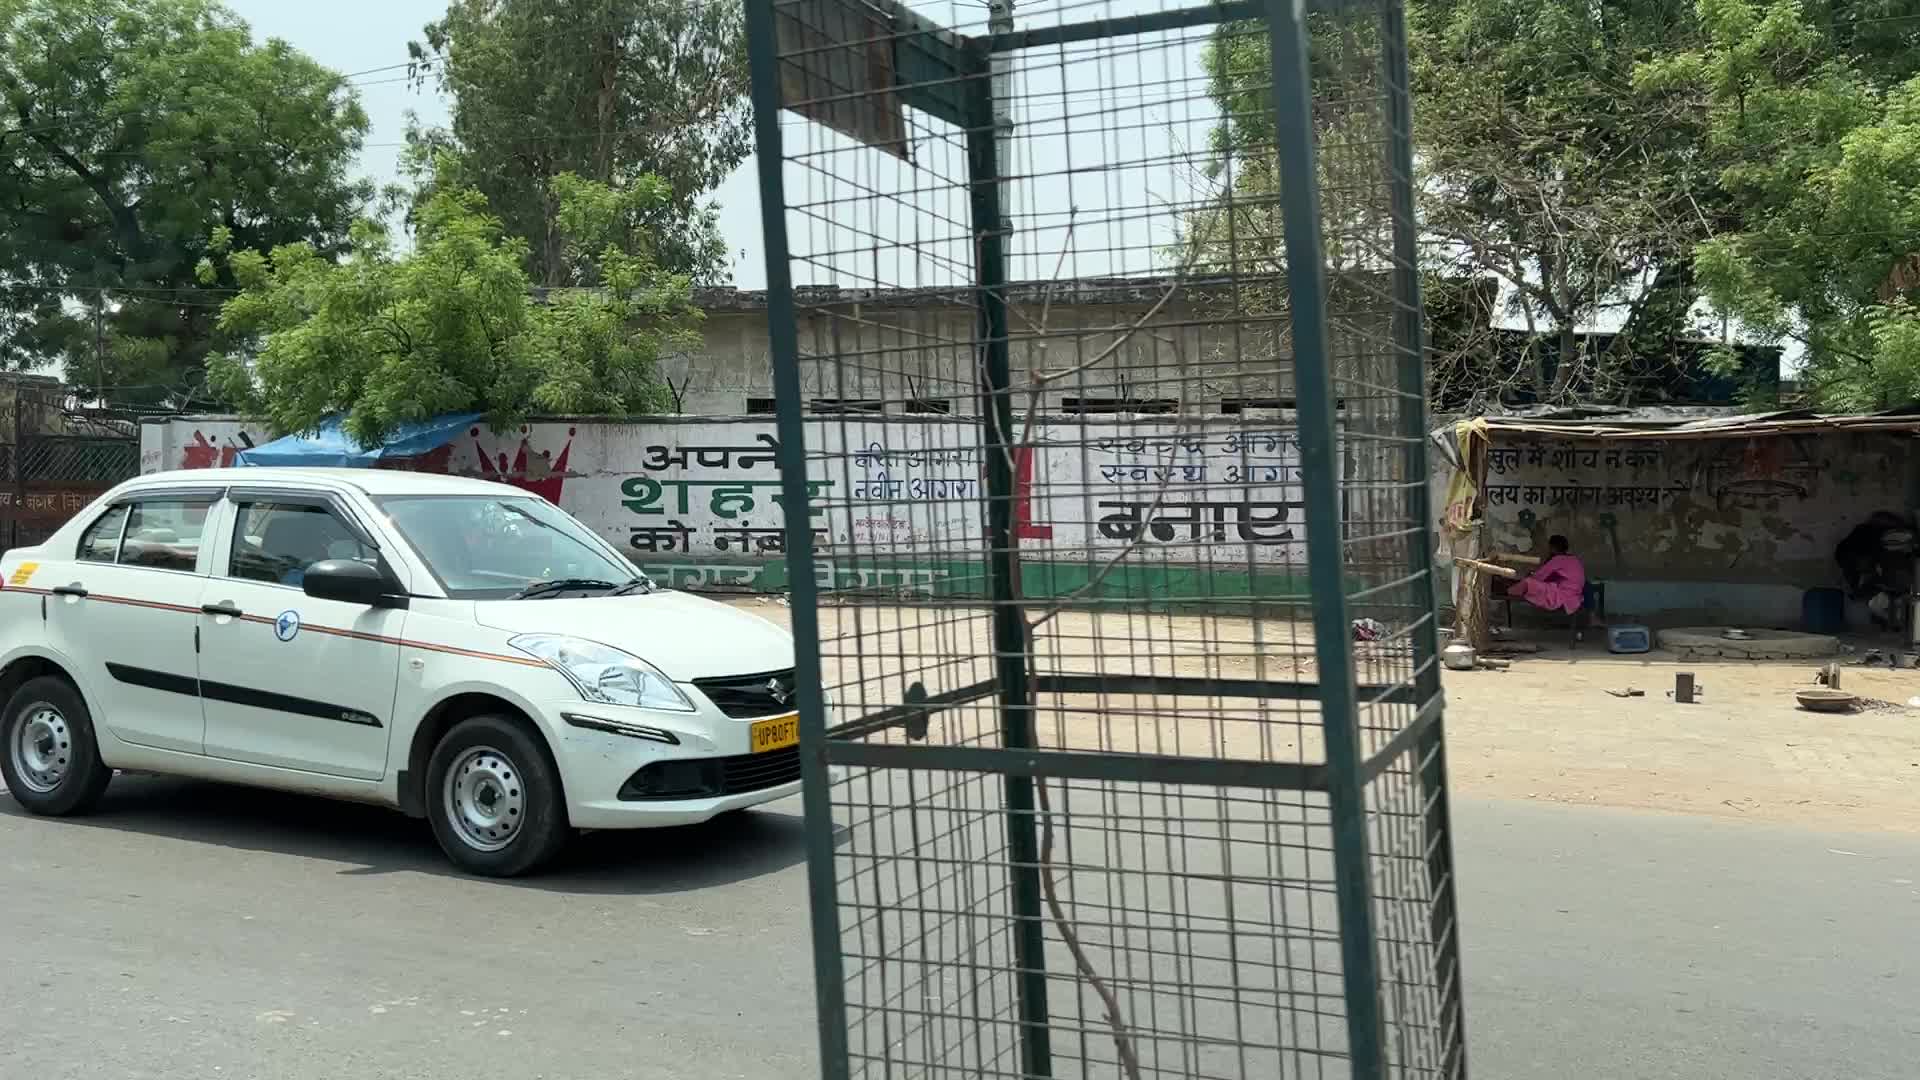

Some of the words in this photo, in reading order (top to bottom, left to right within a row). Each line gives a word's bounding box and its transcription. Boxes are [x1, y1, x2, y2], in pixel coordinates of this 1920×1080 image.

[642, 434, 783, 471] अपने
[855, 472, 905, 498] नवीन
[910, 478, 977, 499] आगरा
[1523, 485, 1547, 505] का
[630, 520, 696, 553] को
[759, 721, 798, 745] UP80FT
